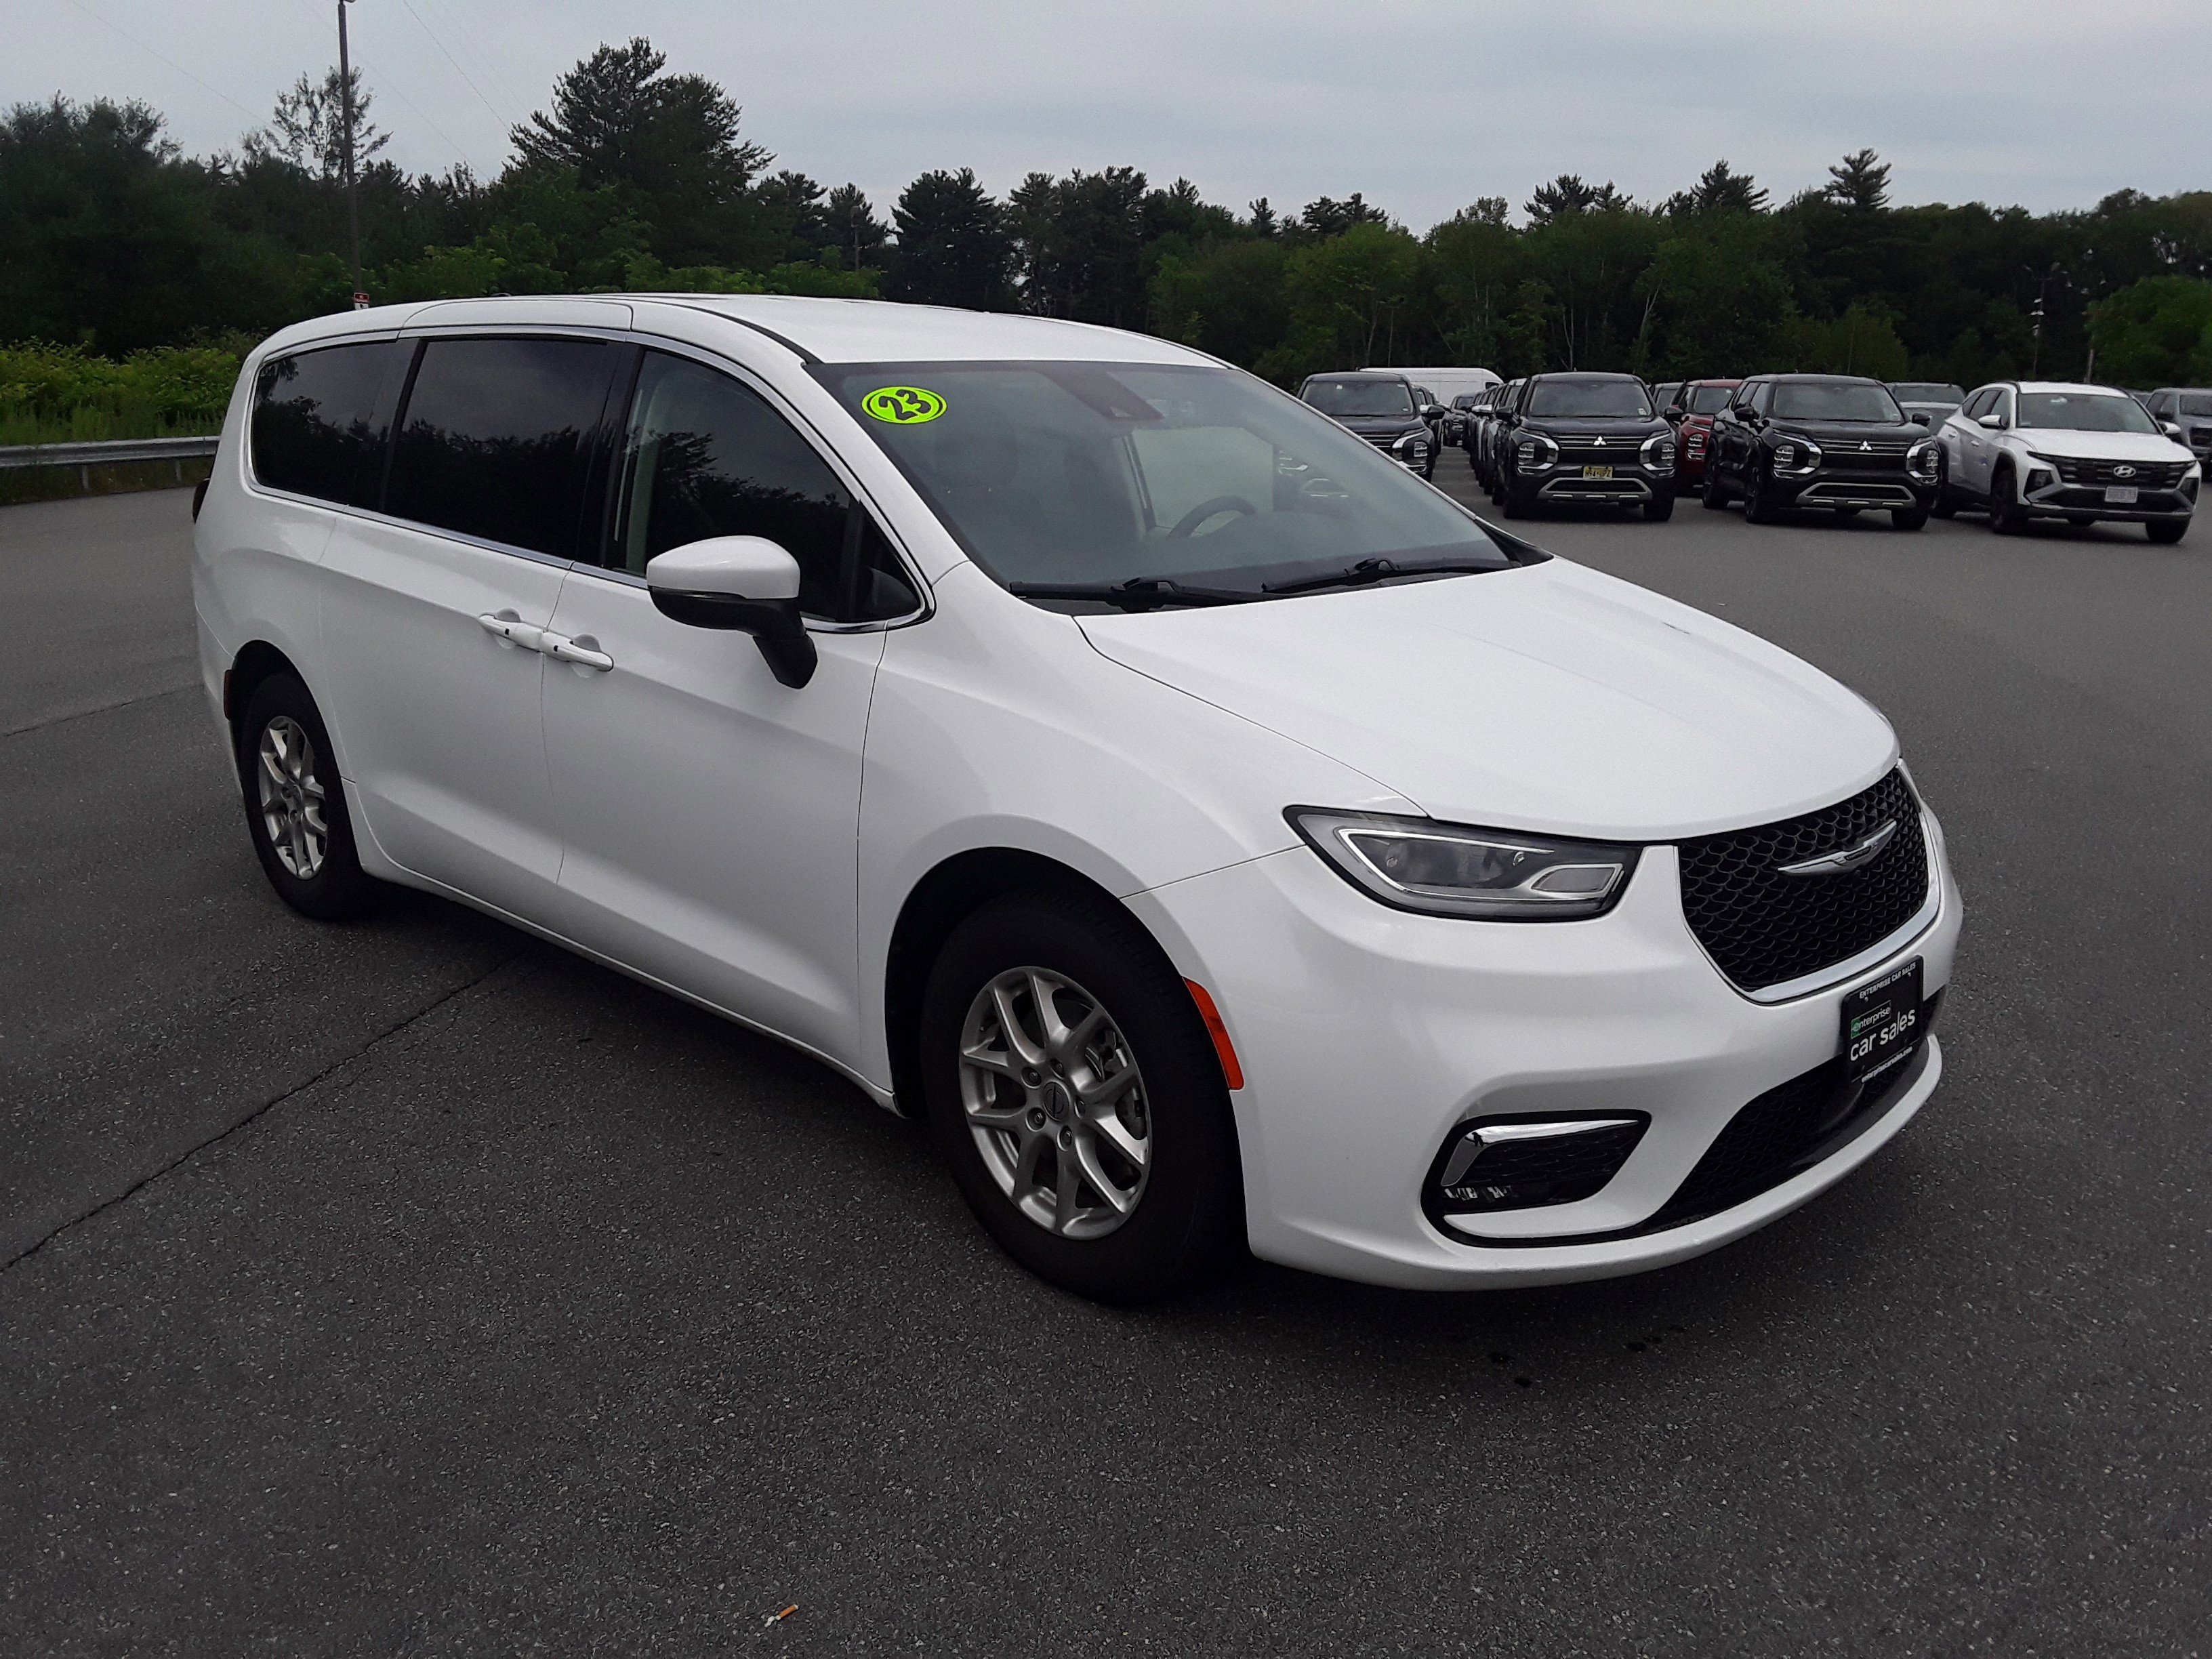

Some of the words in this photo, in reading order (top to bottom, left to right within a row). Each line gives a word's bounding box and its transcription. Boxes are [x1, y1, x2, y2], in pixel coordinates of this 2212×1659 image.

[878, 389, 932, 421] 23
[1891, 970, 1902, 982] CAR
[1902, 962, 1916, 975] SALES
[1851, 1007, 1891, 1032] enterprise
[1850, 1033, 1877, 1061] car
[1879, 1009, 1916, 1046] sales
